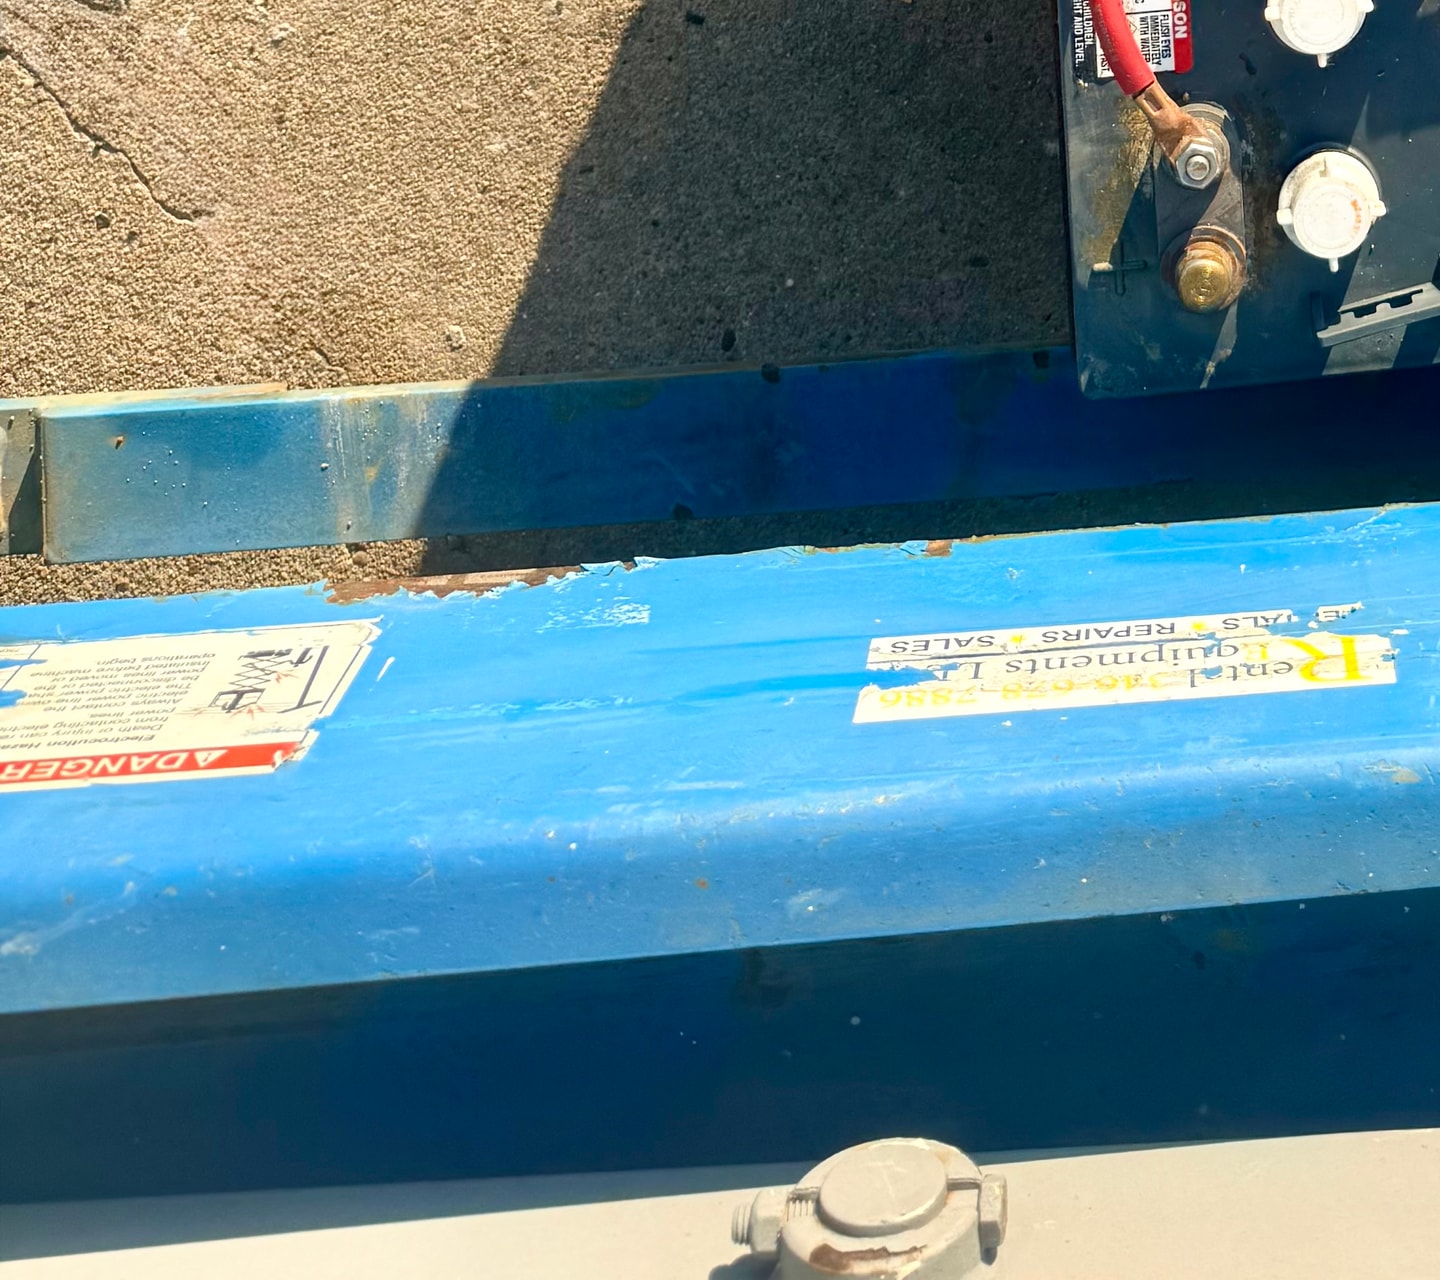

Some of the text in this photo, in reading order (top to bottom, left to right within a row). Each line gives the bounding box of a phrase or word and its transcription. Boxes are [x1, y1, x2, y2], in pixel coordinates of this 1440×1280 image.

[1074, 16, 1083, 35] AND
[1075, 37, 1084, 67] LEVEL.
[1042, 622, 1175, 643] REPAIRS
[890, 635, 995, 653] SALES
[51, 728, 94, 736] injury
[119, 724, 163, 733] Death
[47, 734, 155, 747] Electrocution
[0, 751, 190, 779] DANGER
